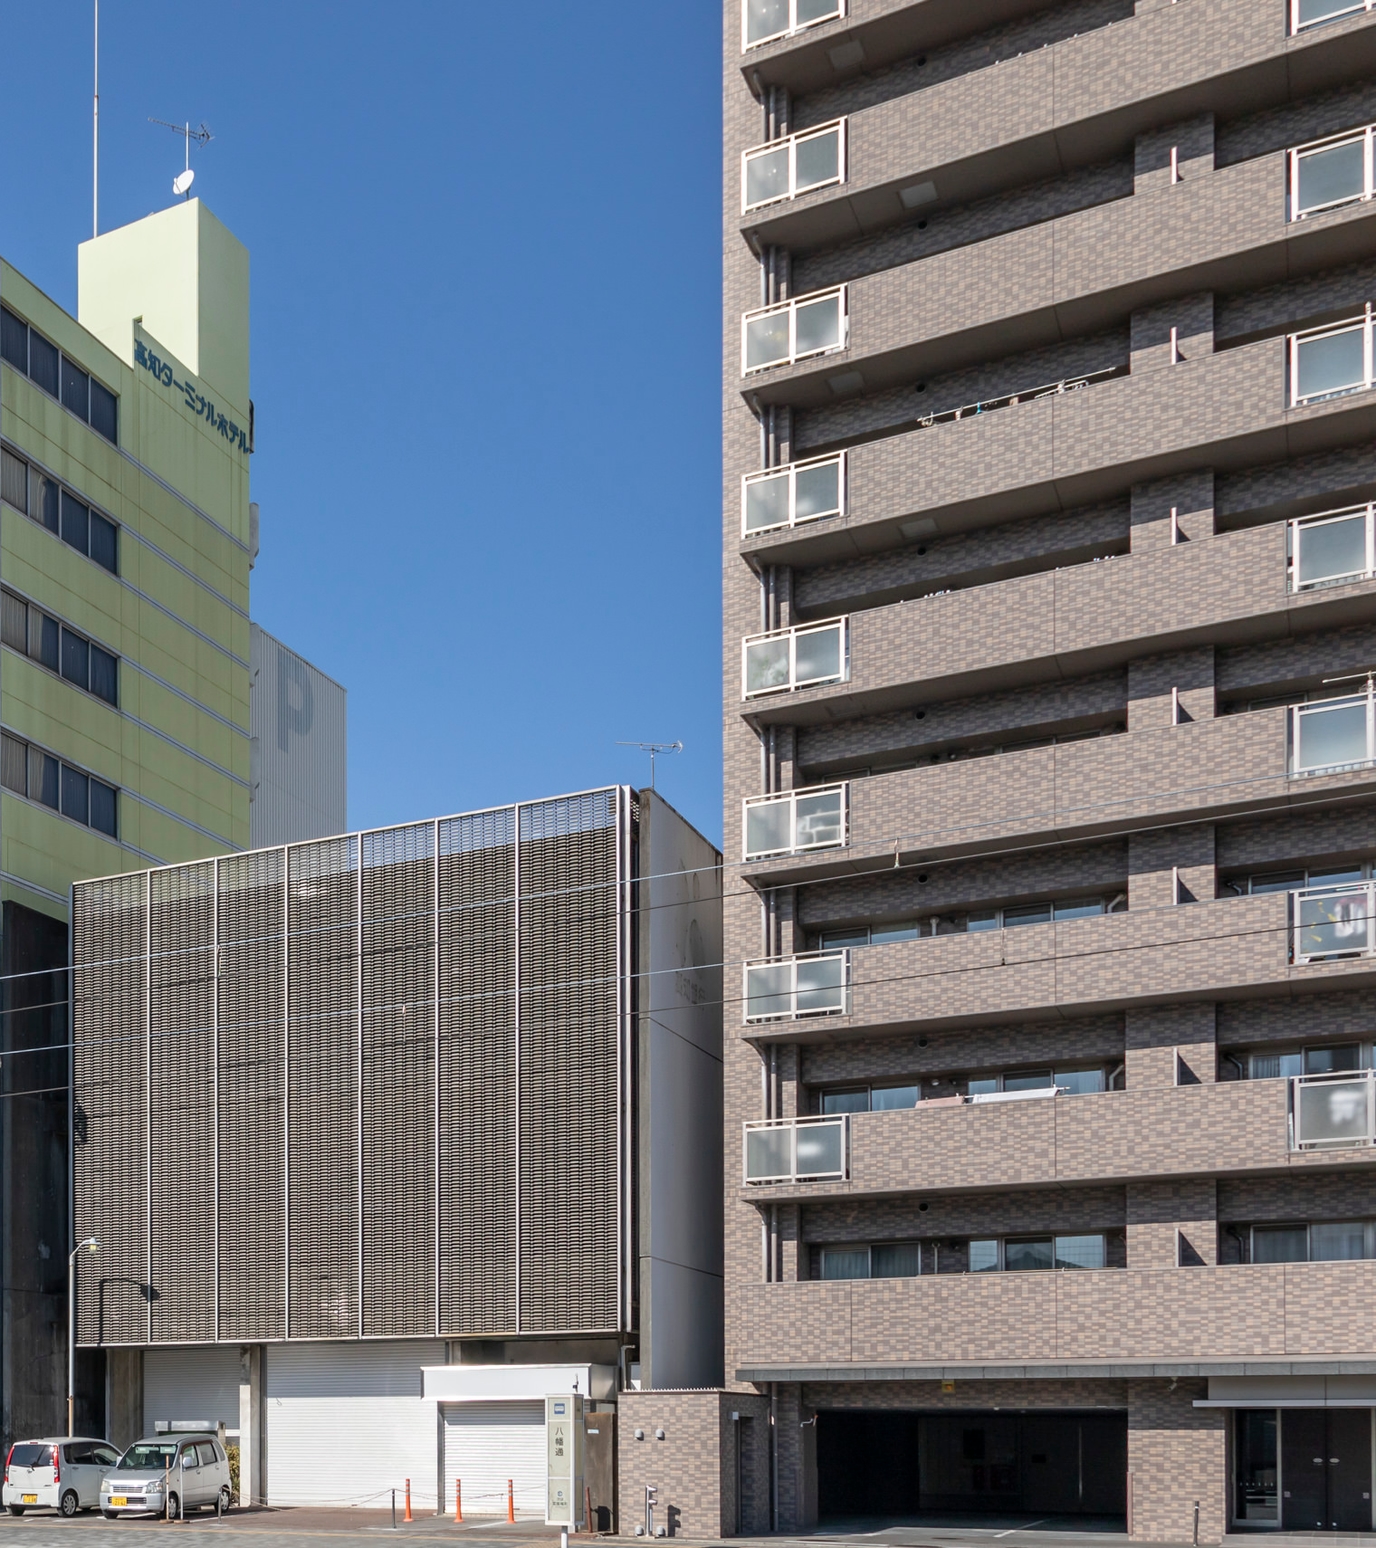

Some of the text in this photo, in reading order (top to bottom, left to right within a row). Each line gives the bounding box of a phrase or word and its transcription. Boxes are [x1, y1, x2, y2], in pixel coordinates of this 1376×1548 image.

[134, 338, 250, 454] 高知ターミナルホテル
[555, 1427, 564, 1457] 八幡通
